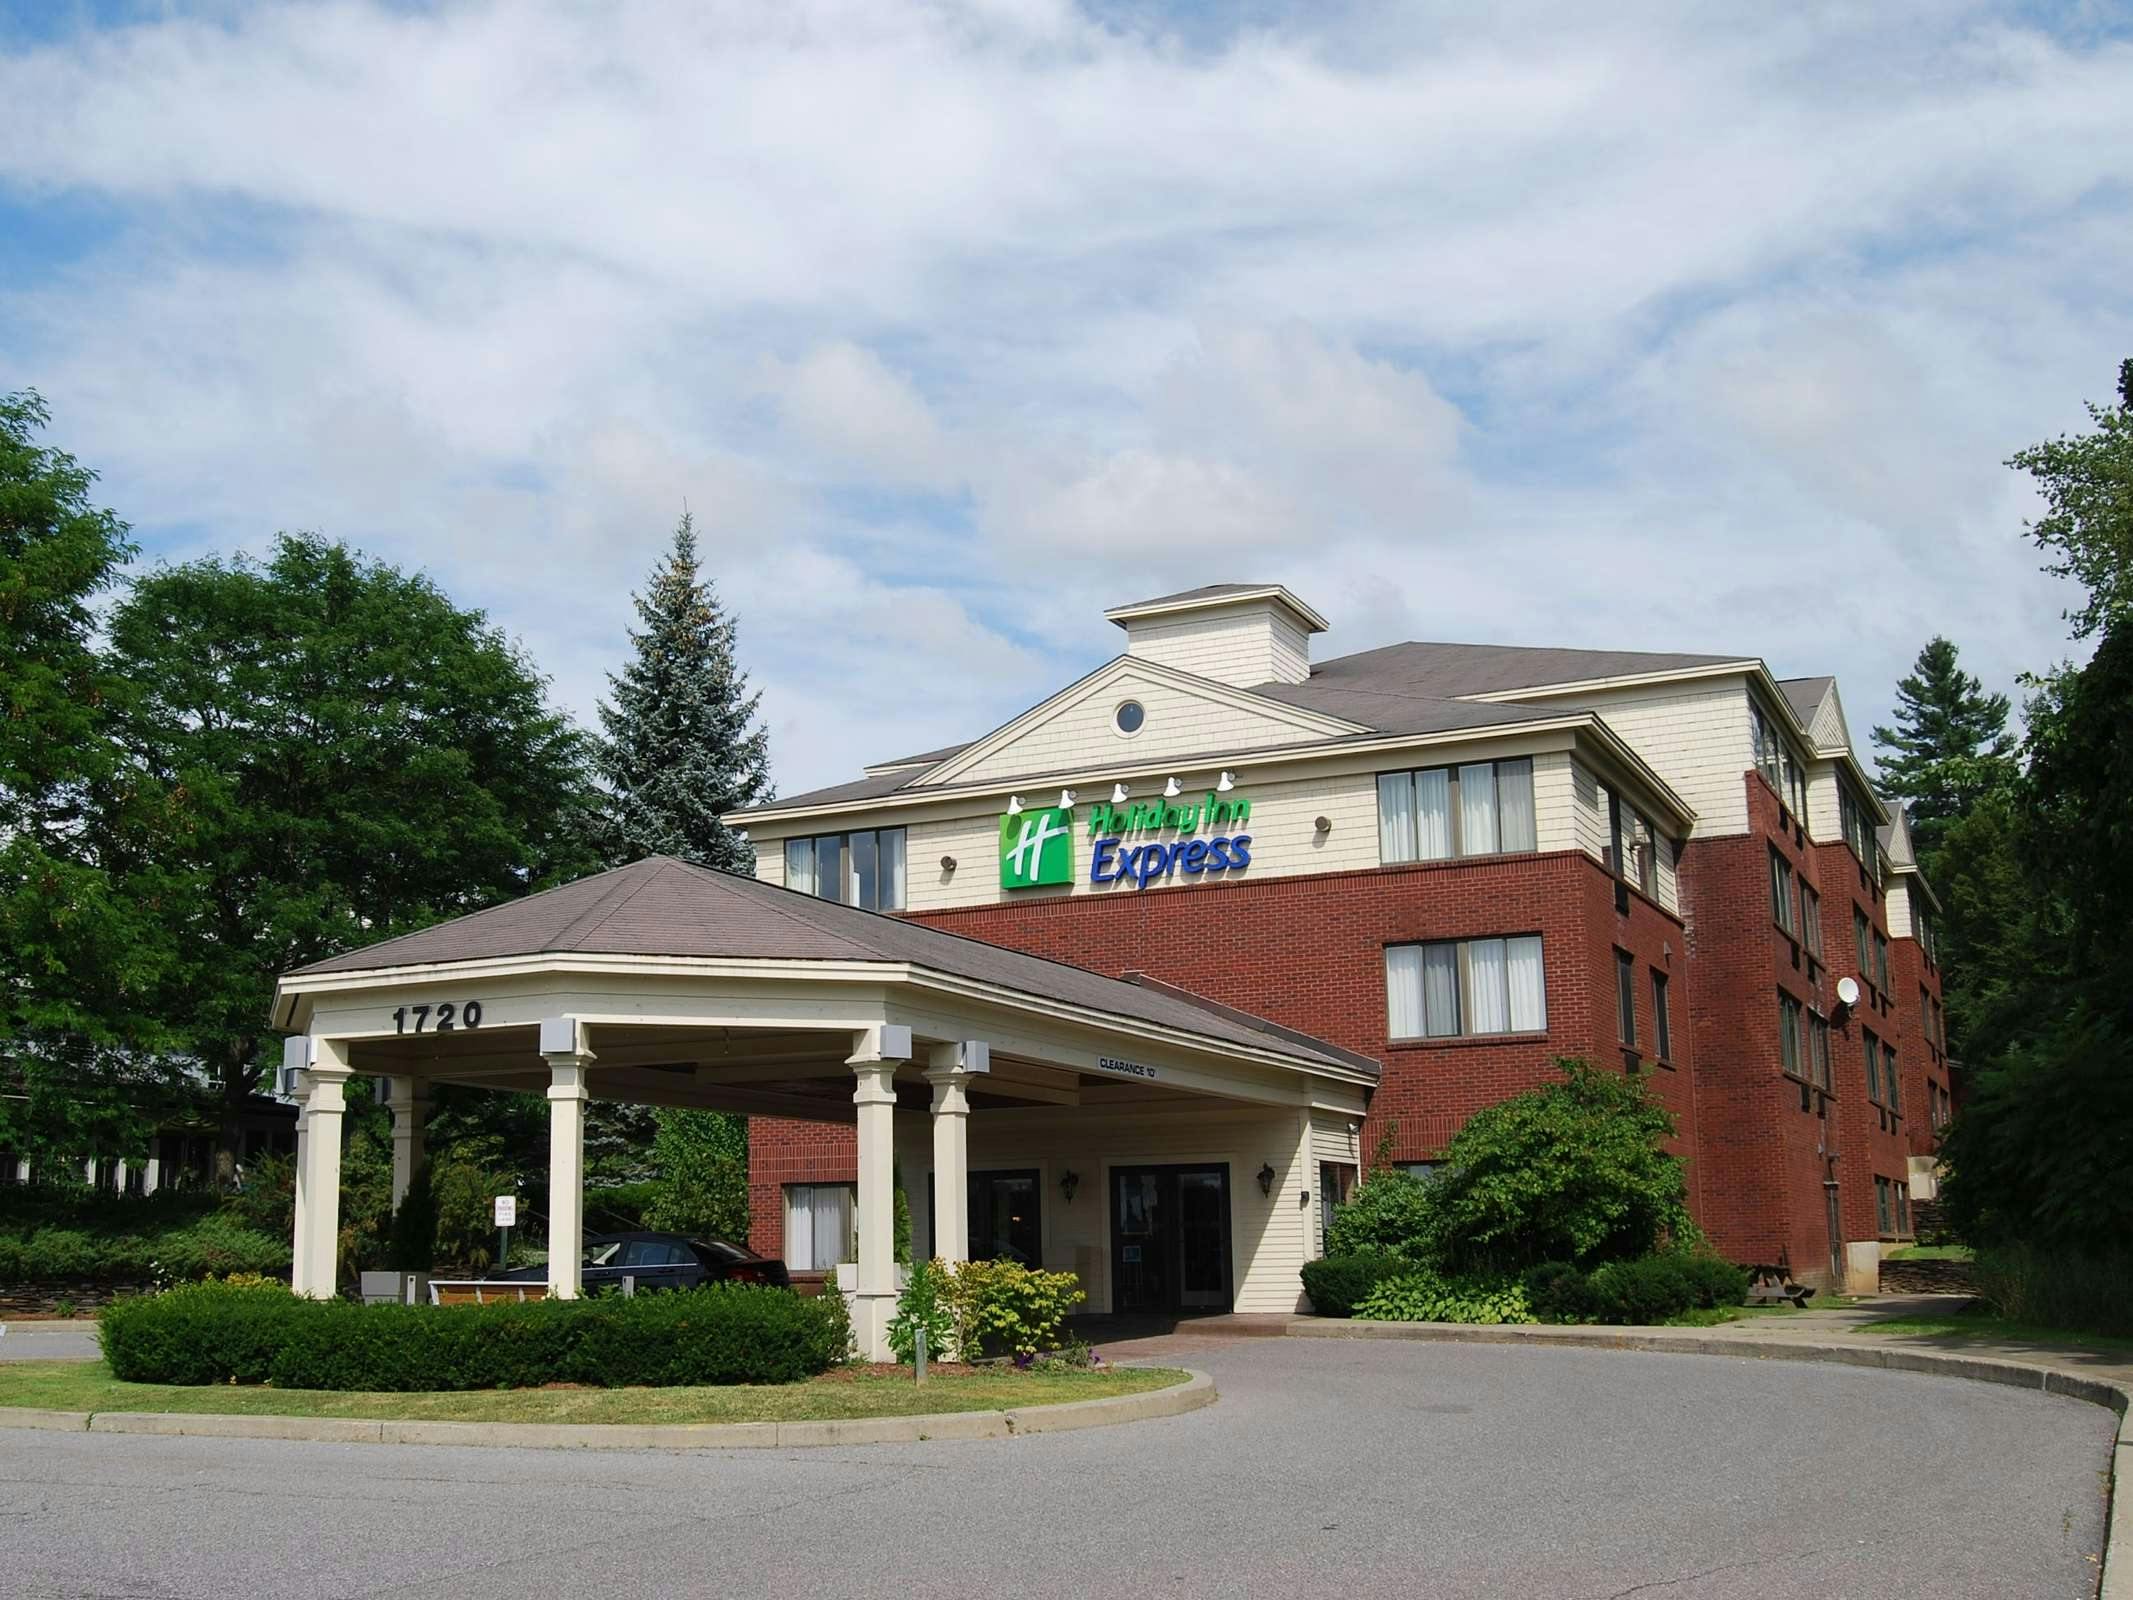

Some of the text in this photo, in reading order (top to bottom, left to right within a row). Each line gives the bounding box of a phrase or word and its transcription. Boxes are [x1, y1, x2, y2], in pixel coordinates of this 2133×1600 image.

[1088, 793, 1249, 836] Holiday Inn
[1090, 835, 1252, 890] Express
[392, 1001, 482, 1033] 1720
[1100, 1058, 1145, 1076] CLEARANCE
